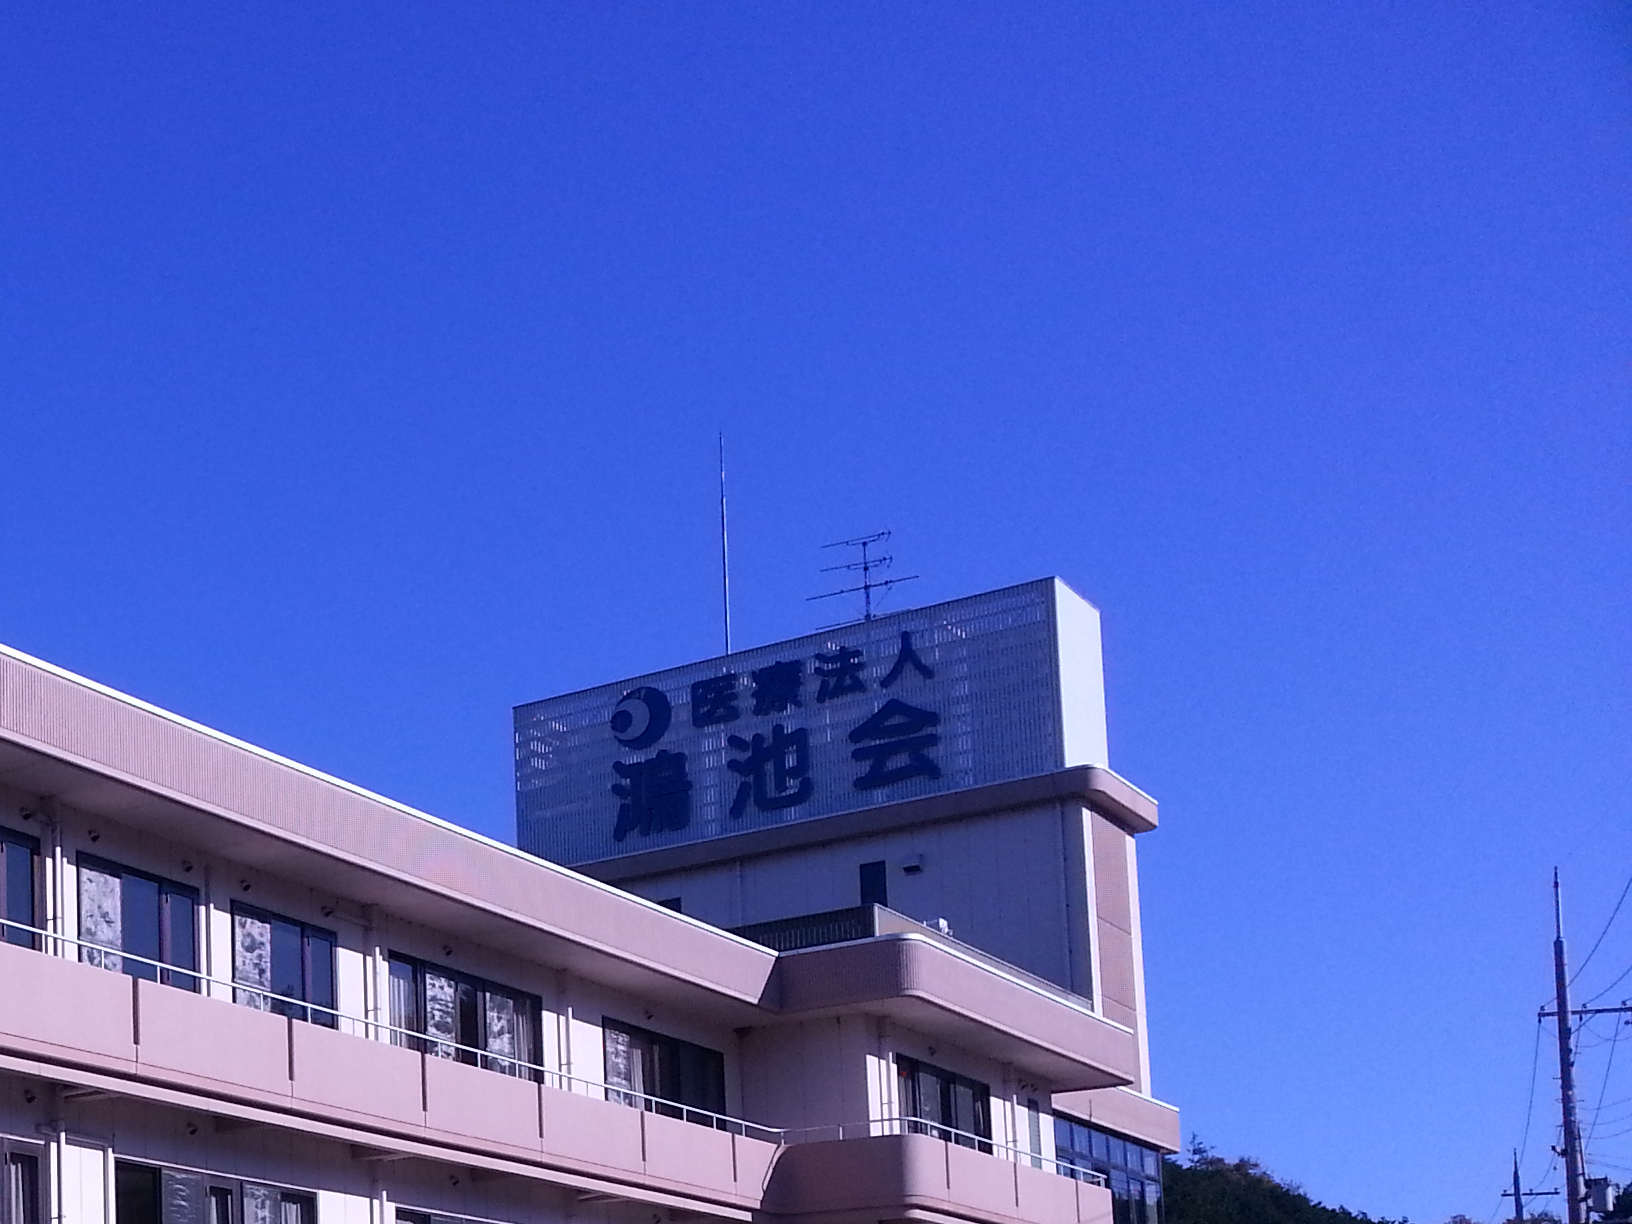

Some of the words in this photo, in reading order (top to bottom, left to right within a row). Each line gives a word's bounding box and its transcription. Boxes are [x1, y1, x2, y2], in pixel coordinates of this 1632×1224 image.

[689, 630, 936, 729] 医療法人
[610, 698, 942, 842] 鴻池会
